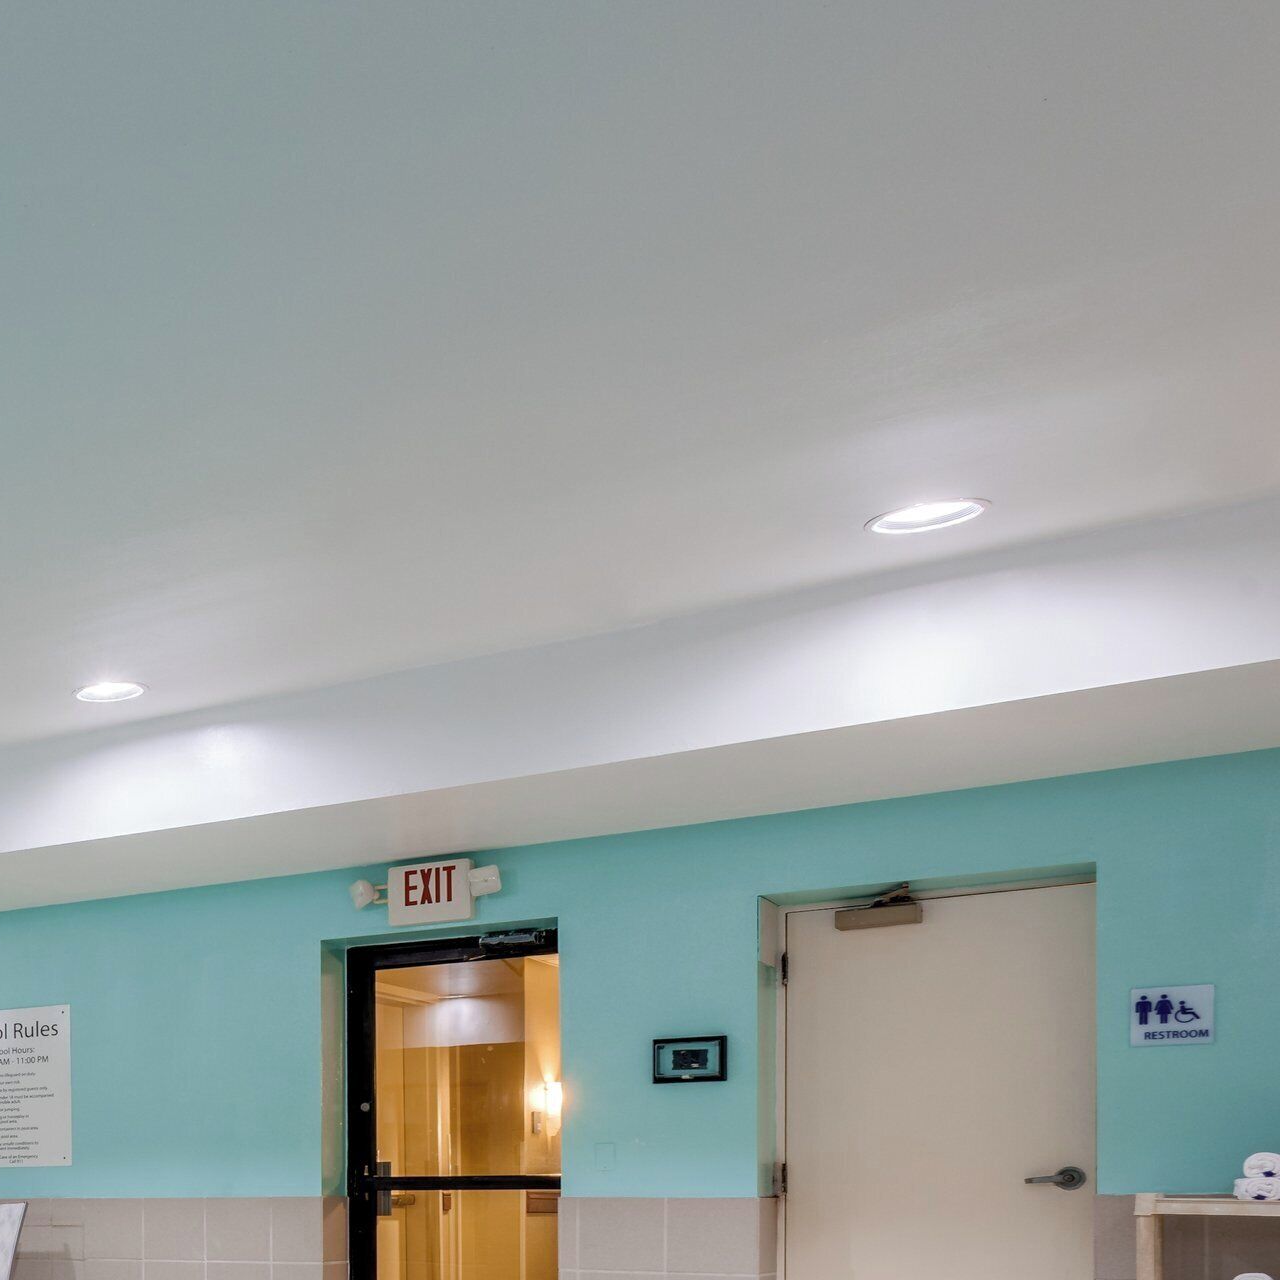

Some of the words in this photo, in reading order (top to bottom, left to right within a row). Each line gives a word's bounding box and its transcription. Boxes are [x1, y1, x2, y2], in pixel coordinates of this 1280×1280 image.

[405, 865, 456, 907] EXIT
[13, 1021, 58, 1039] Rules
[1144, 1029, 1209, 1041] RESTROOM
[11, 1047, 36, 1055] Hours:
[16, 1057, 36, 1065] 11:00
[37, 1055, 49, 1063] PM
